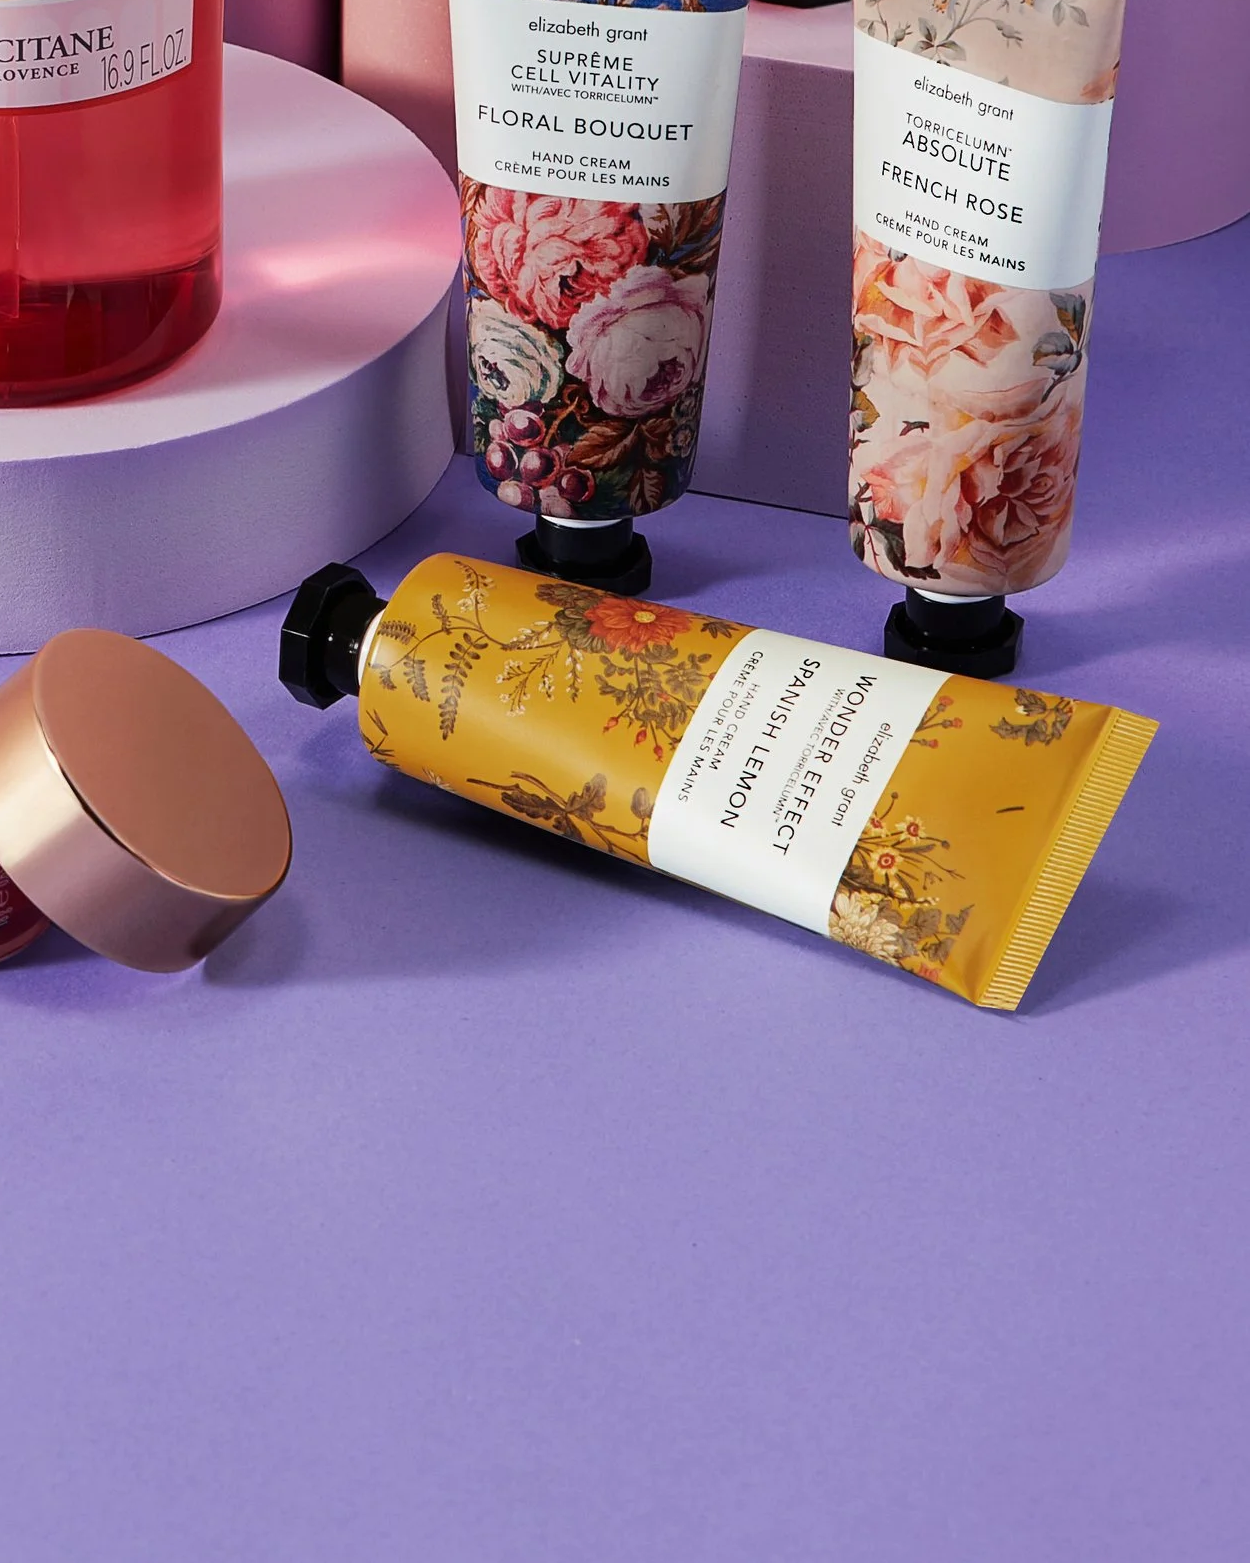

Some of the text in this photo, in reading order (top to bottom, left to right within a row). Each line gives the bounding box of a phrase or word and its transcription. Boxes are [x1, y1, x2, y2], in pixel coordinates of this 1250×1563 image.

[529, 17, 648, 43] elizabeth grant
[101, 51, 135, 91] 16.9
[511, 65, 659, 91] CELL VITALITY
[537, 49, 633, 71] SUPRÊME
[511, 84, 570, 98] WITH/AVEC
[914, 74, 1014, 120] elizabeth grant
[478, 105, 694, 141] FLORAL BOUQUET
[494, 159, 670, 187] CRÈME POUR LES MAINS
[532, 151, 631, 169] HAND CREAM
[902, 130, 1010, 181] ABSOLUTE
[881, 161, 1024, 224] FRENCH ROSE
[876, 211, 1026, 271] CRÈME POUR LES MAINS
[905, 210, 988, 247] HAND CREAM
[678, 650, 763, 802] CRÈME POUR LES MAINS
[709, 683, 760, 770] HAND CREAM
[808, 688, 845, 742] WITH/AVEC
[720, 658, 820, 829] SPANISH LEMON
[773, 674, 877, 856] WONDER EFFECT
[831, 721, 892, 827] elizabeth grant
